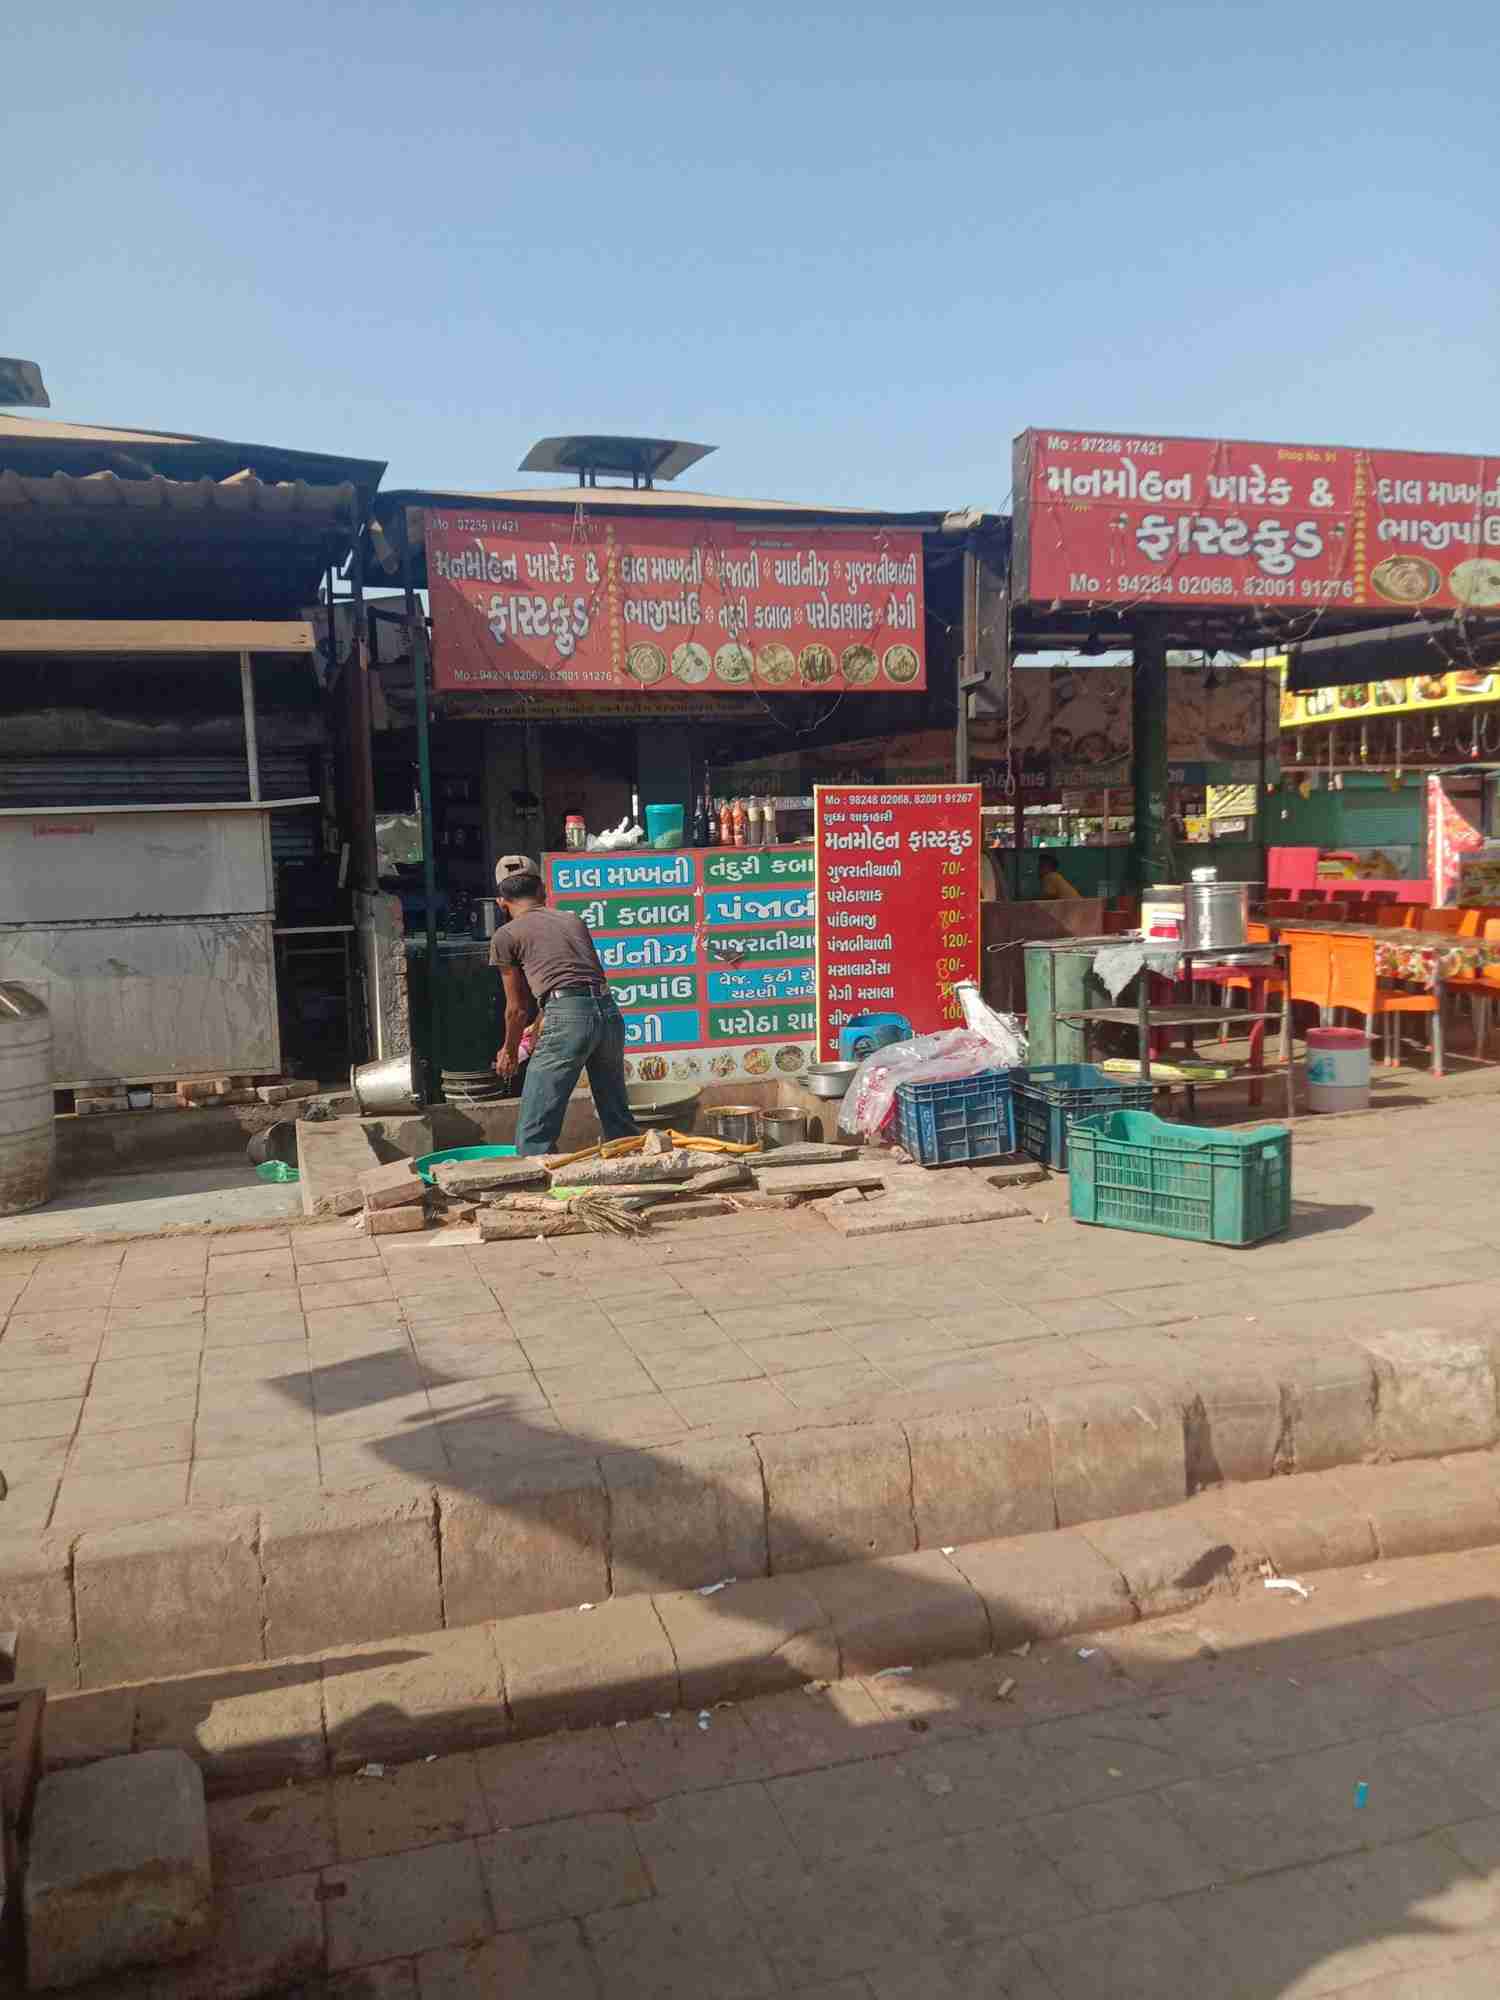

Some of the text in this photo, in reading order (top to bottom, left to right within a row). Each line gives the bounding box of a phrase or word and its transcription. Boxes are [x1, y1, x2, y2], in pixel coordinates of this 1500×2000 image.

[1047, 436, 1069, 451] Mo
[1126, 440, 1164, 456] 17421
[1047, 457, 1335, 507] મનમોહન ખારેક &
[1377, 477, 1423, 506] દાલ
[435, 538, 518, 584] મનમોહન
[525, 541, 577, 584] ખારેક
[1069, 571, 1099, 593] Mo
[1117, 574, 1173, 594] 94284
[753, 605, 793, 630] કબાબ
[886, 594, 917, 630] મેગી
[824, 824, 900, 851] મનમોહન
[557, 867, 601, 888] દાલ
[709, 856, 816, 882] તંદુરી કબા
[826, 860, 902, 884] ગુજરાતીથાળી
[941, 861, 966, 876] 70/-
[826, 886, 884, 904] પરોઠાશાક
[941, 885, 966, 900] 50/-
[579, 900, 690, 928] હીં કબાબ
[942, 934, 974, 948] 120/-
[827, 983, 895, 1001] મેગી મસાલા
[718, 1009, 817, 1035] પરોઠા શા
